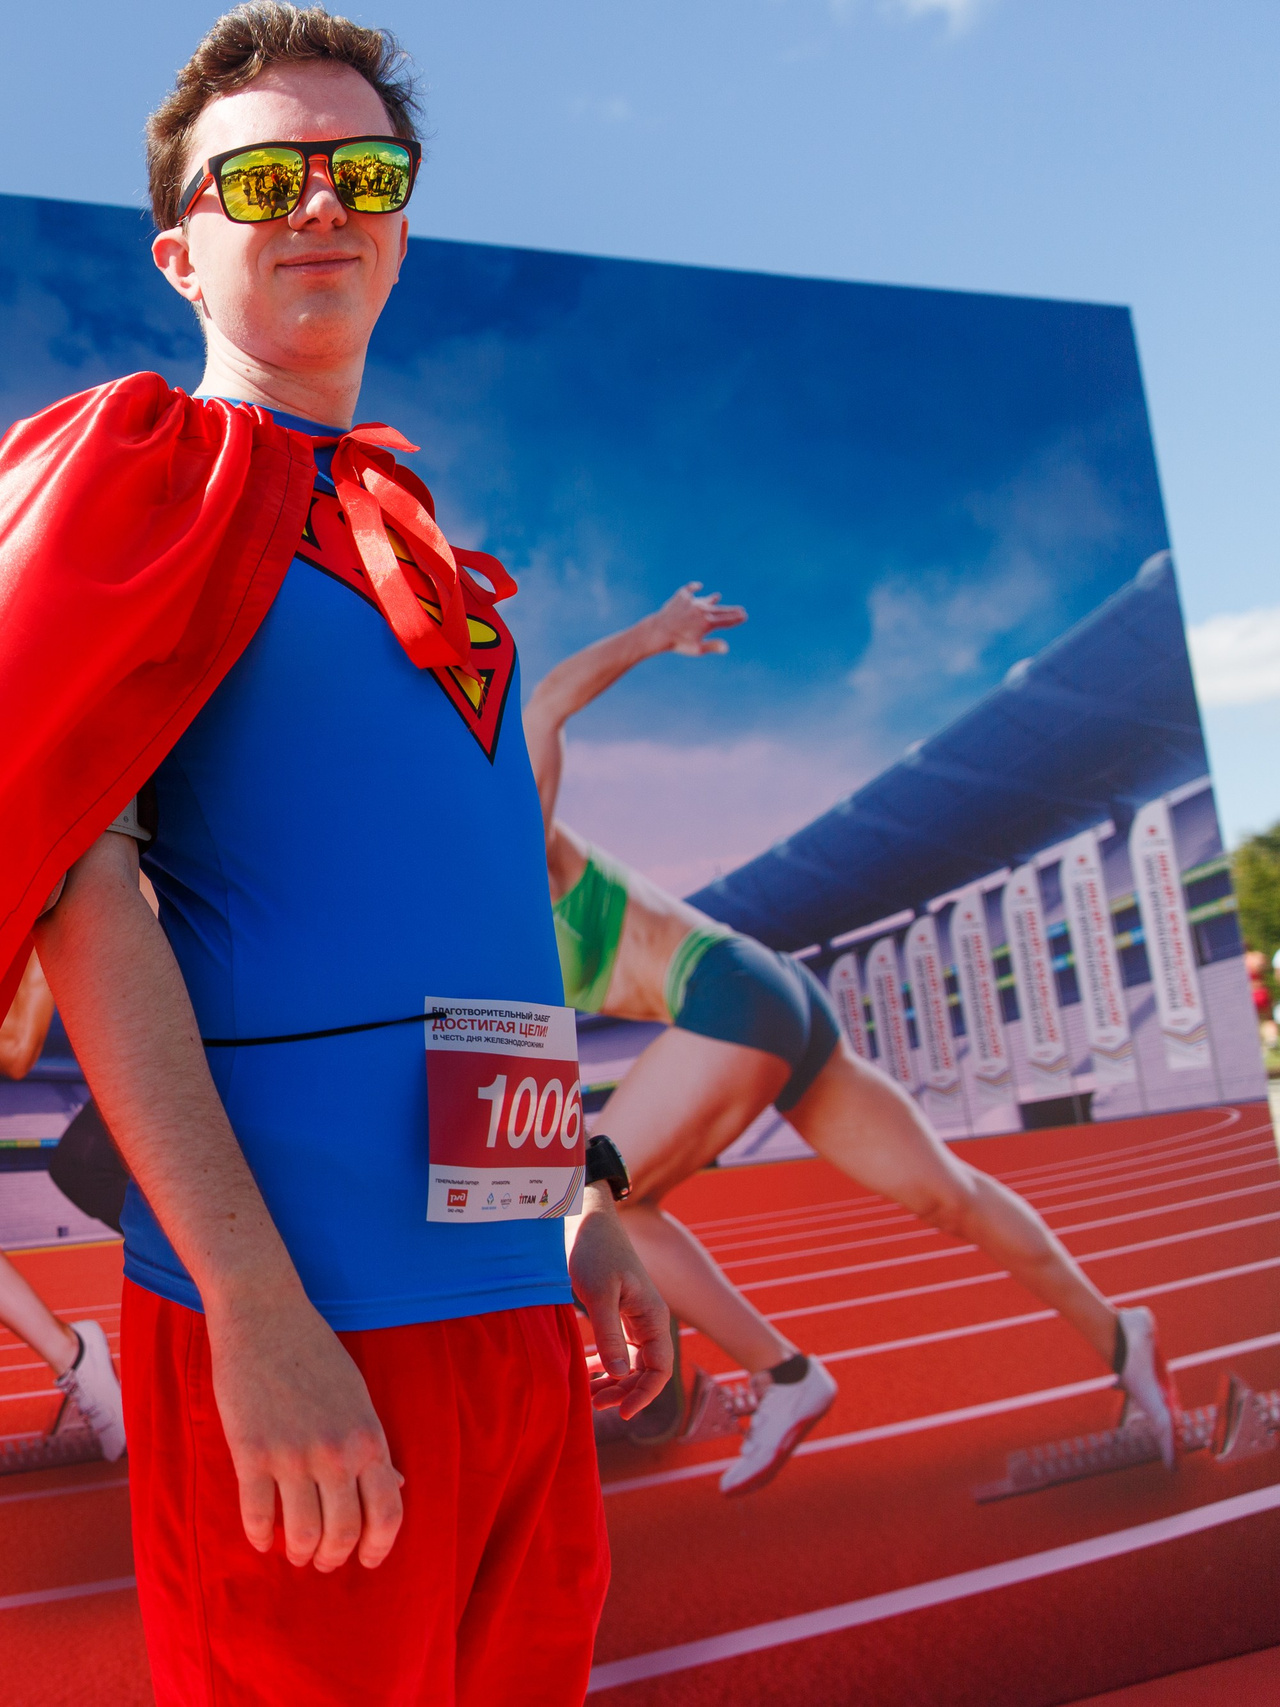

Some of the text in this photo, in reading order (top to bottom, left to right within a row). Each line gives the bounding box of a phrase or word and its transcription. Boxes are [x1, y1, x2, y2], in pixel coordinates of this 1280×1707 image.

[432, 1017, 549, 1038] ДОСТИГАЯ ЦЕЛИ!
[440, 1034, 465, 1042] ЧЕСТЬ
[466, 1035, 482, 1043] ДНЯ
[477, 1074, 581, 1150] 1006
